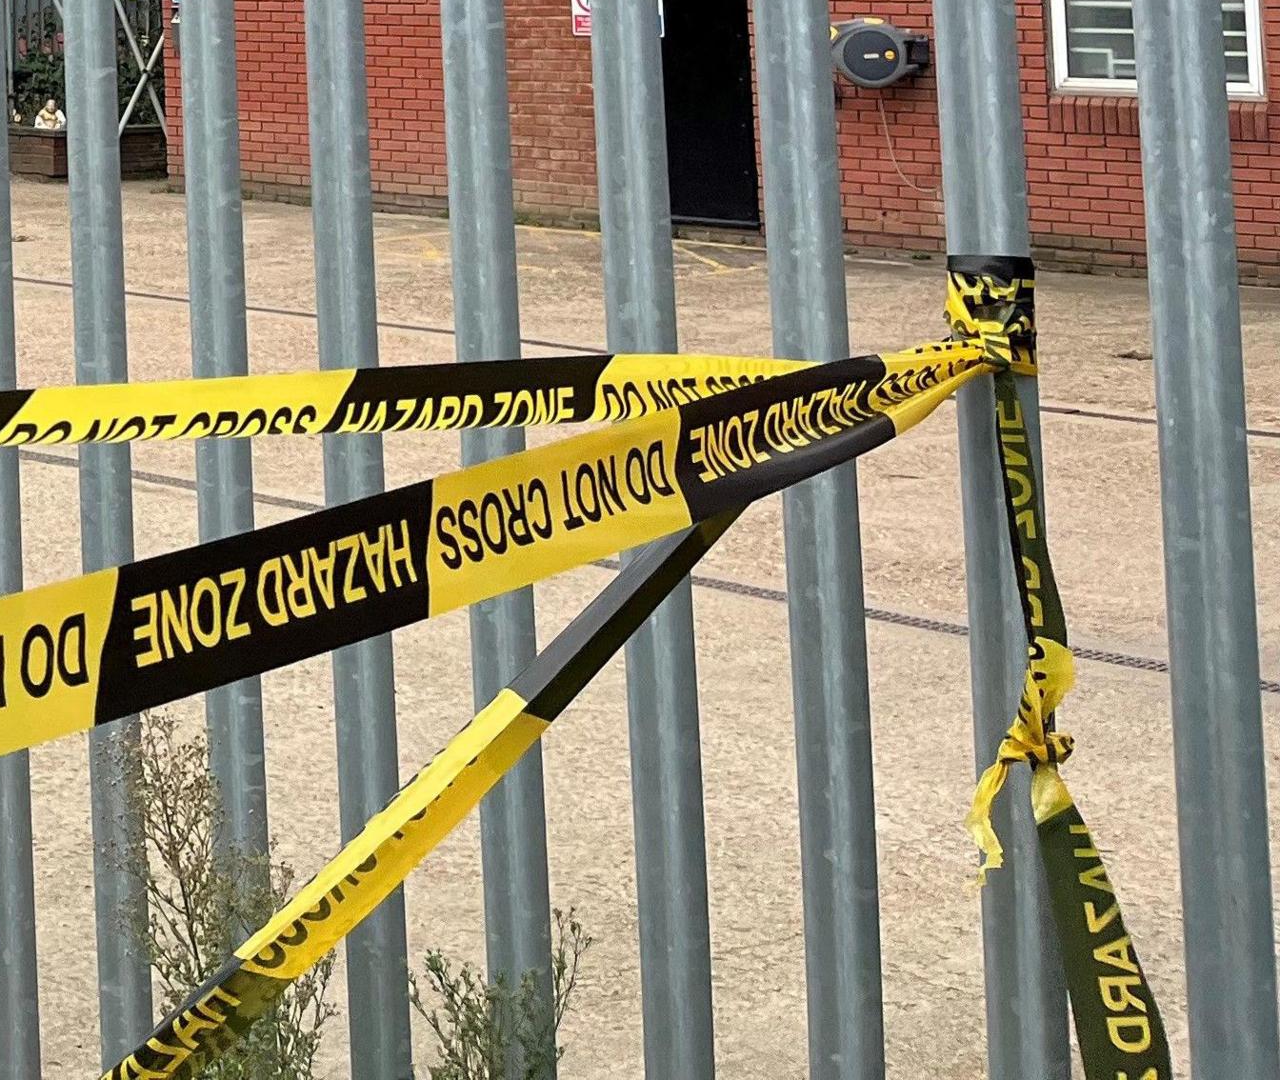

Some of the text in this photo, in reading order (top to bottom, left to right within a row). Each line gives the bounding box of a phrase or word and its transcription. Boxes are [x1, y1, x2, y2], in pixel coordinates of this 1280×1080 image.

[690, 380, 874, 483] HAZARD ZONE
[437, 440, 676, 570] DO NOT CROSS
[131, 518, 419, 668] HAZARD ZONE
[20, 613, 90, 698] DO
